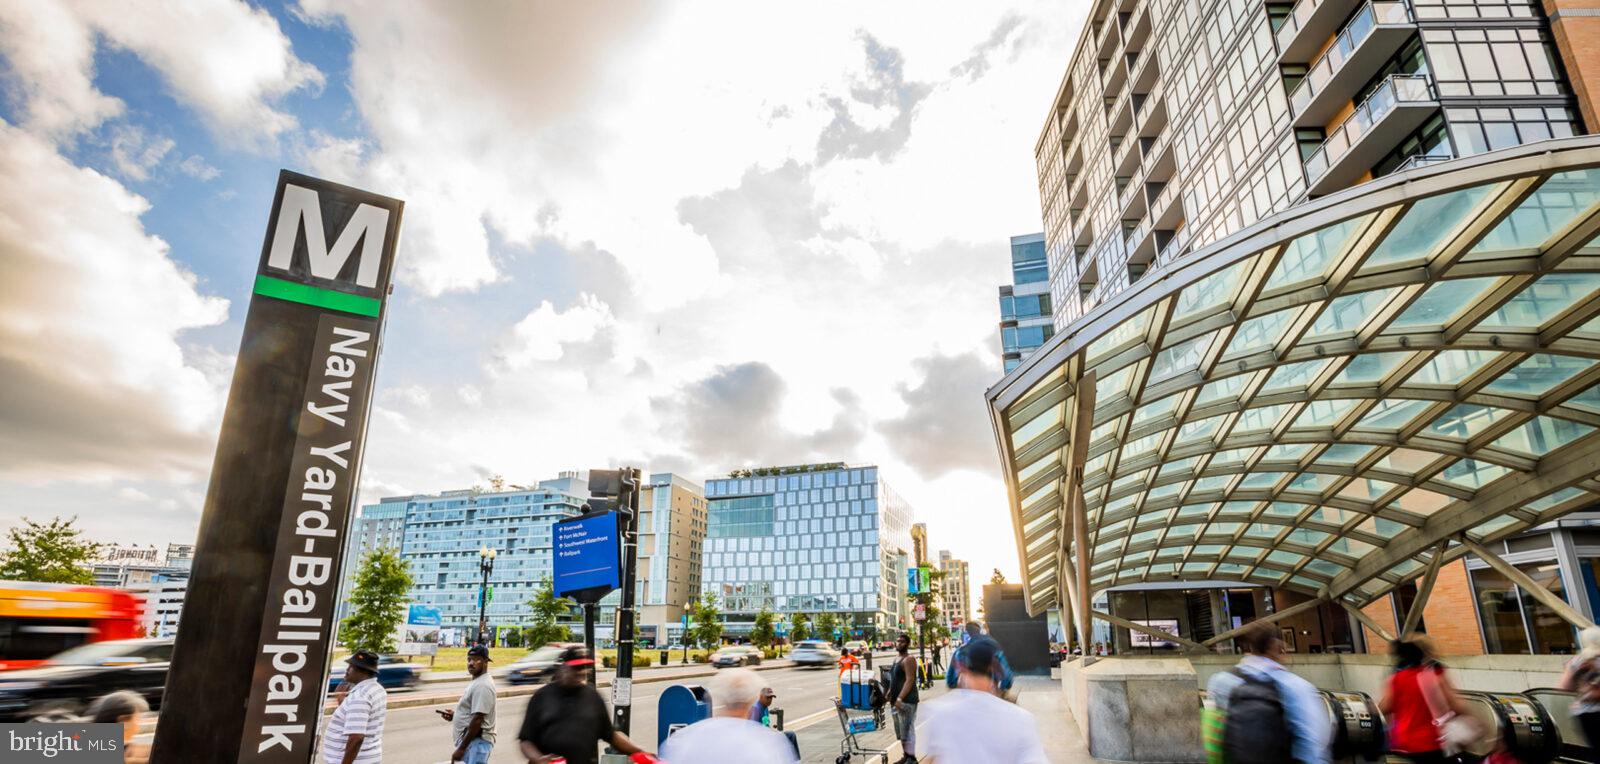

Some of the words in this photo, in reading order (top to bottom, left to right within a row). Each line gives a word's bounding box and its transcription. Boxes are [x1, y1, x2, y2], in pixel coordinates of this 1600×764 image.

[268, 183, 389, 289] M
[307, 326, 371, 427] Navy
[563, 523, 583, 531] Riverwalk
[585, 536, 608, 544] Waterfront
[258, 440, 352, 753] Yard-Ballpark
